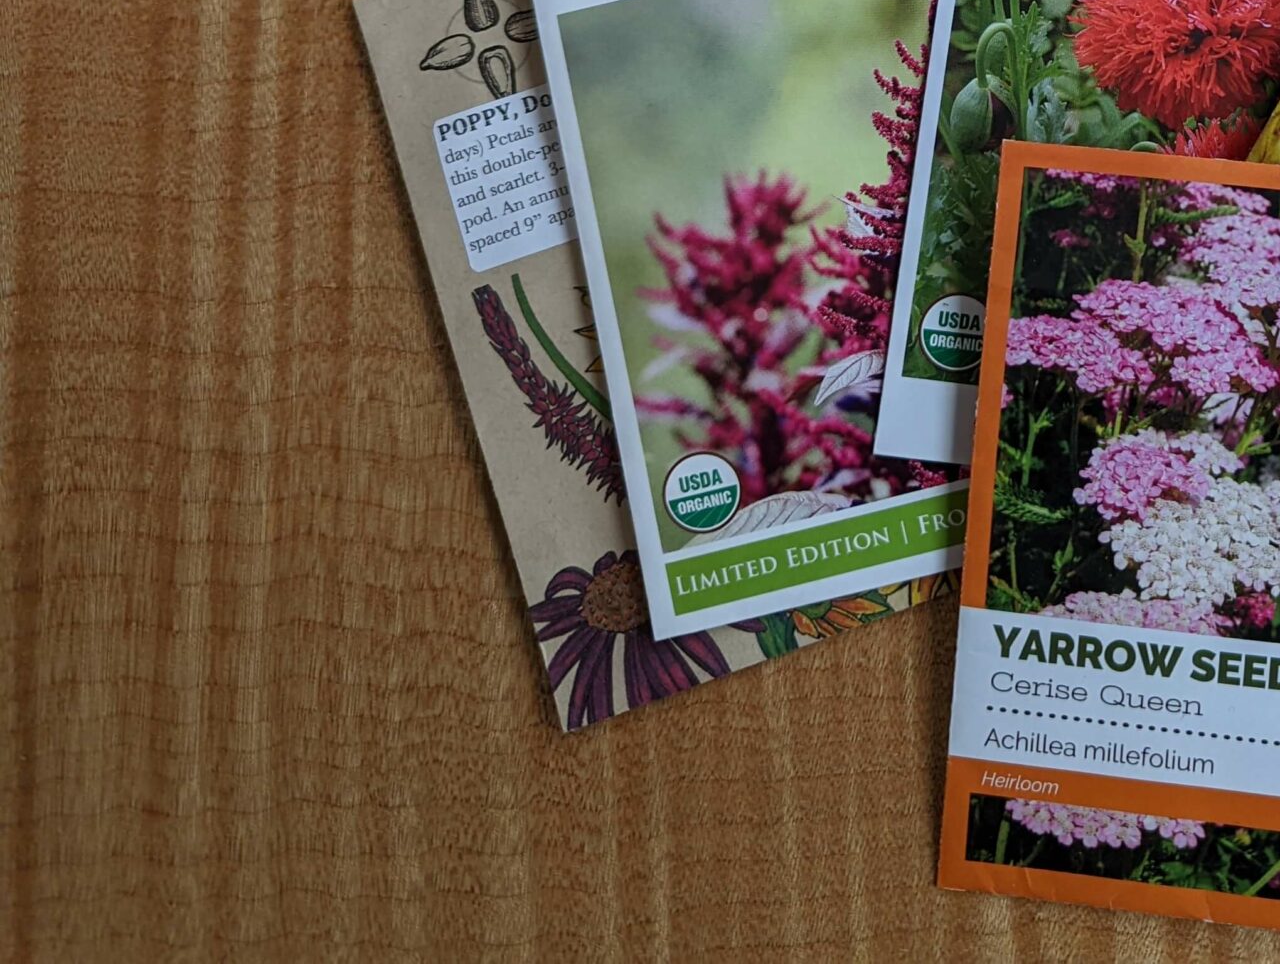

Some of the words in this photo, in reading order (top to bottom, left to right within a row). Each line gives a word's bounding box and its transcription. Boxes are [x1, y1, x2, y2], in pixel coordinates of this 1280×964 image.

[438, 102, 518, 142] POPPY,
[444, 139, 483, 164] days)
[486, 125, 534, 150] Petals
[450, 167, 478, 186] this
[456, 186, 486, 208] and
[490, 171, 545, 197] scarlet.
[461, 207, 497, 234] pod.
[503, 200, 525, 215] An
[469, 220, 521, 253] spaced
[938, 310, 980, 331] USDA
[929, 333, 983, 352] ORGANIC
[679, 468, 723, 493] USDA
[678, 490, 732, 515] ORGANIC
[675, 555, 777, 596] LIMITED
[785, 526, 890, 569] EDITION
[992, 624, 1184, 678] YARROW
[990, 671, 1088, 703] Cerise
[1100, 685, 1204, 716] Queen
[984, 728, 1077, 757] Achillea
[1084, 742, 1215, 775] millefolium
[981, 770, 1059, 796] Heirloom
